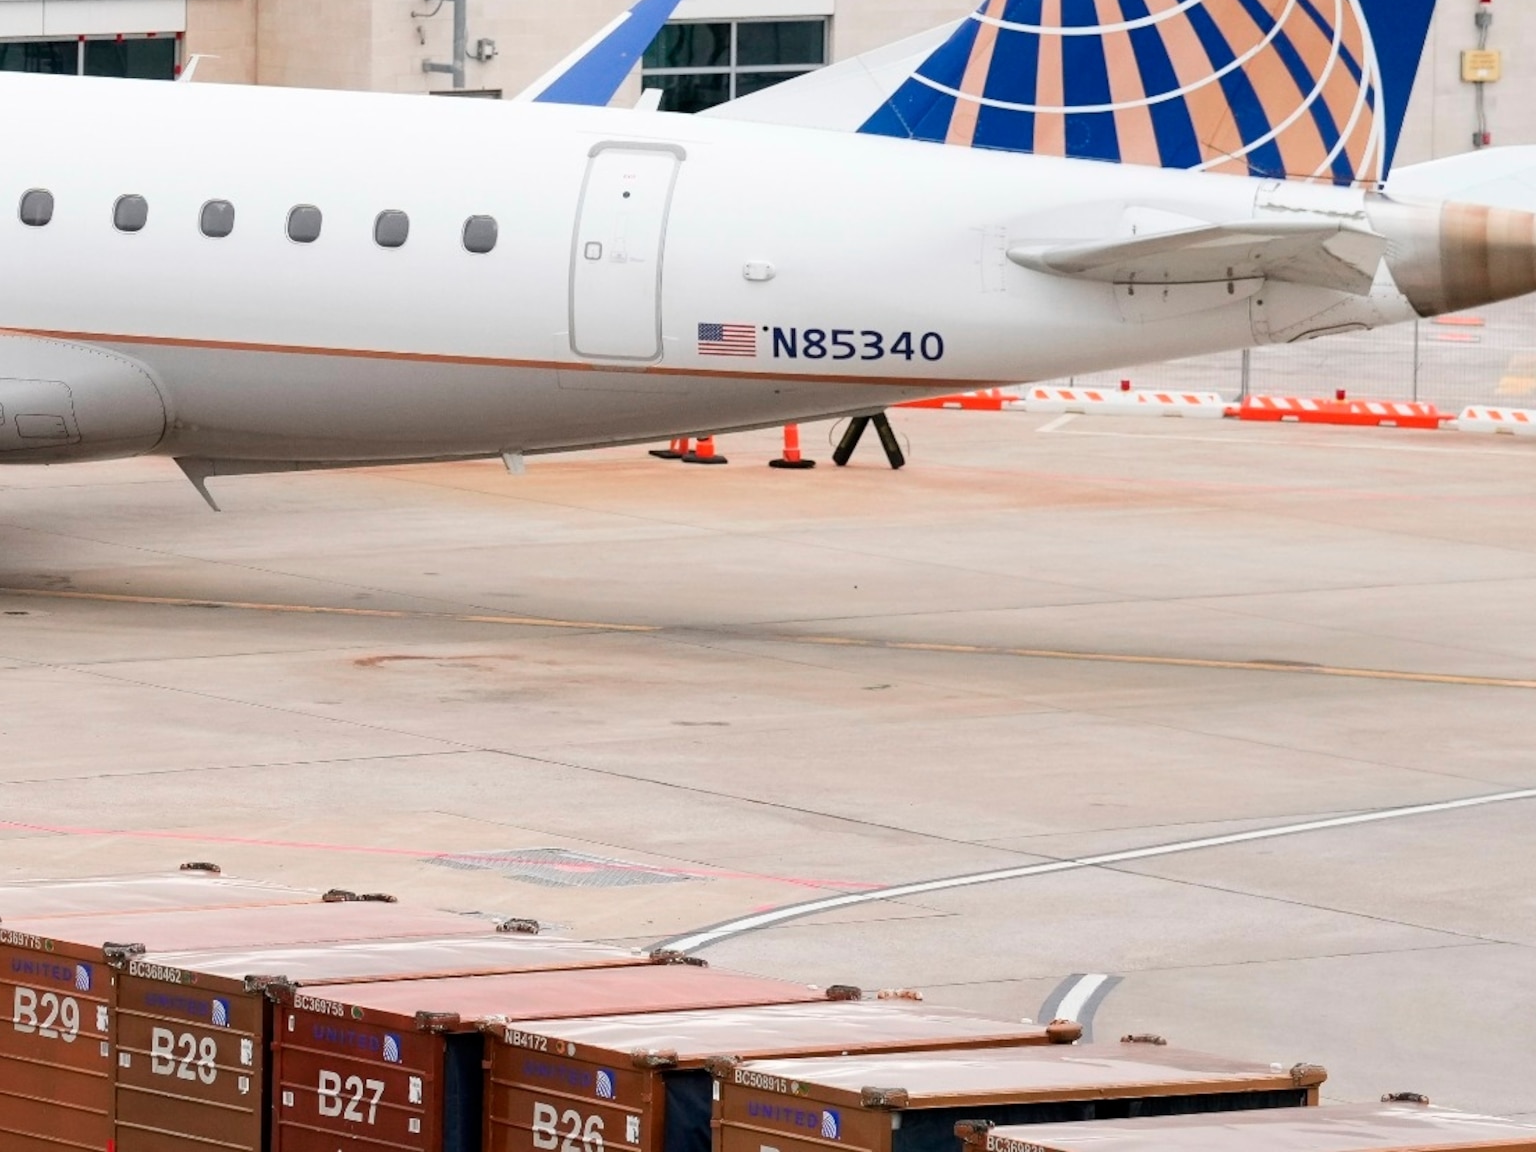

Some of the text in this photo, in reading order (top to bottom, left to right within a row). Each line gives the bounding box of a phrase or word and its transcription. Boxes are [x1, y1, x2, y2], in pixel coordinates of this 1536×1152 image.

[773, 326, 945, 362] N85340
[11, 959, 73, 981] UNITED
[129, 960, 182, 984] BC368462
[13, 986, 80, 1043] B29
[313, 1025, 381, 1051] UNITED
[504, 1028, 548, 1051] NB4172
[151, 1027, 218, 1085] B28
[734, 1069, 787, 1094] BC508915
[318, 1069, 385, 1125] B27
[532, 1101, 605, 1152] B26
[748, 1100, 819, 1129] UNITED
